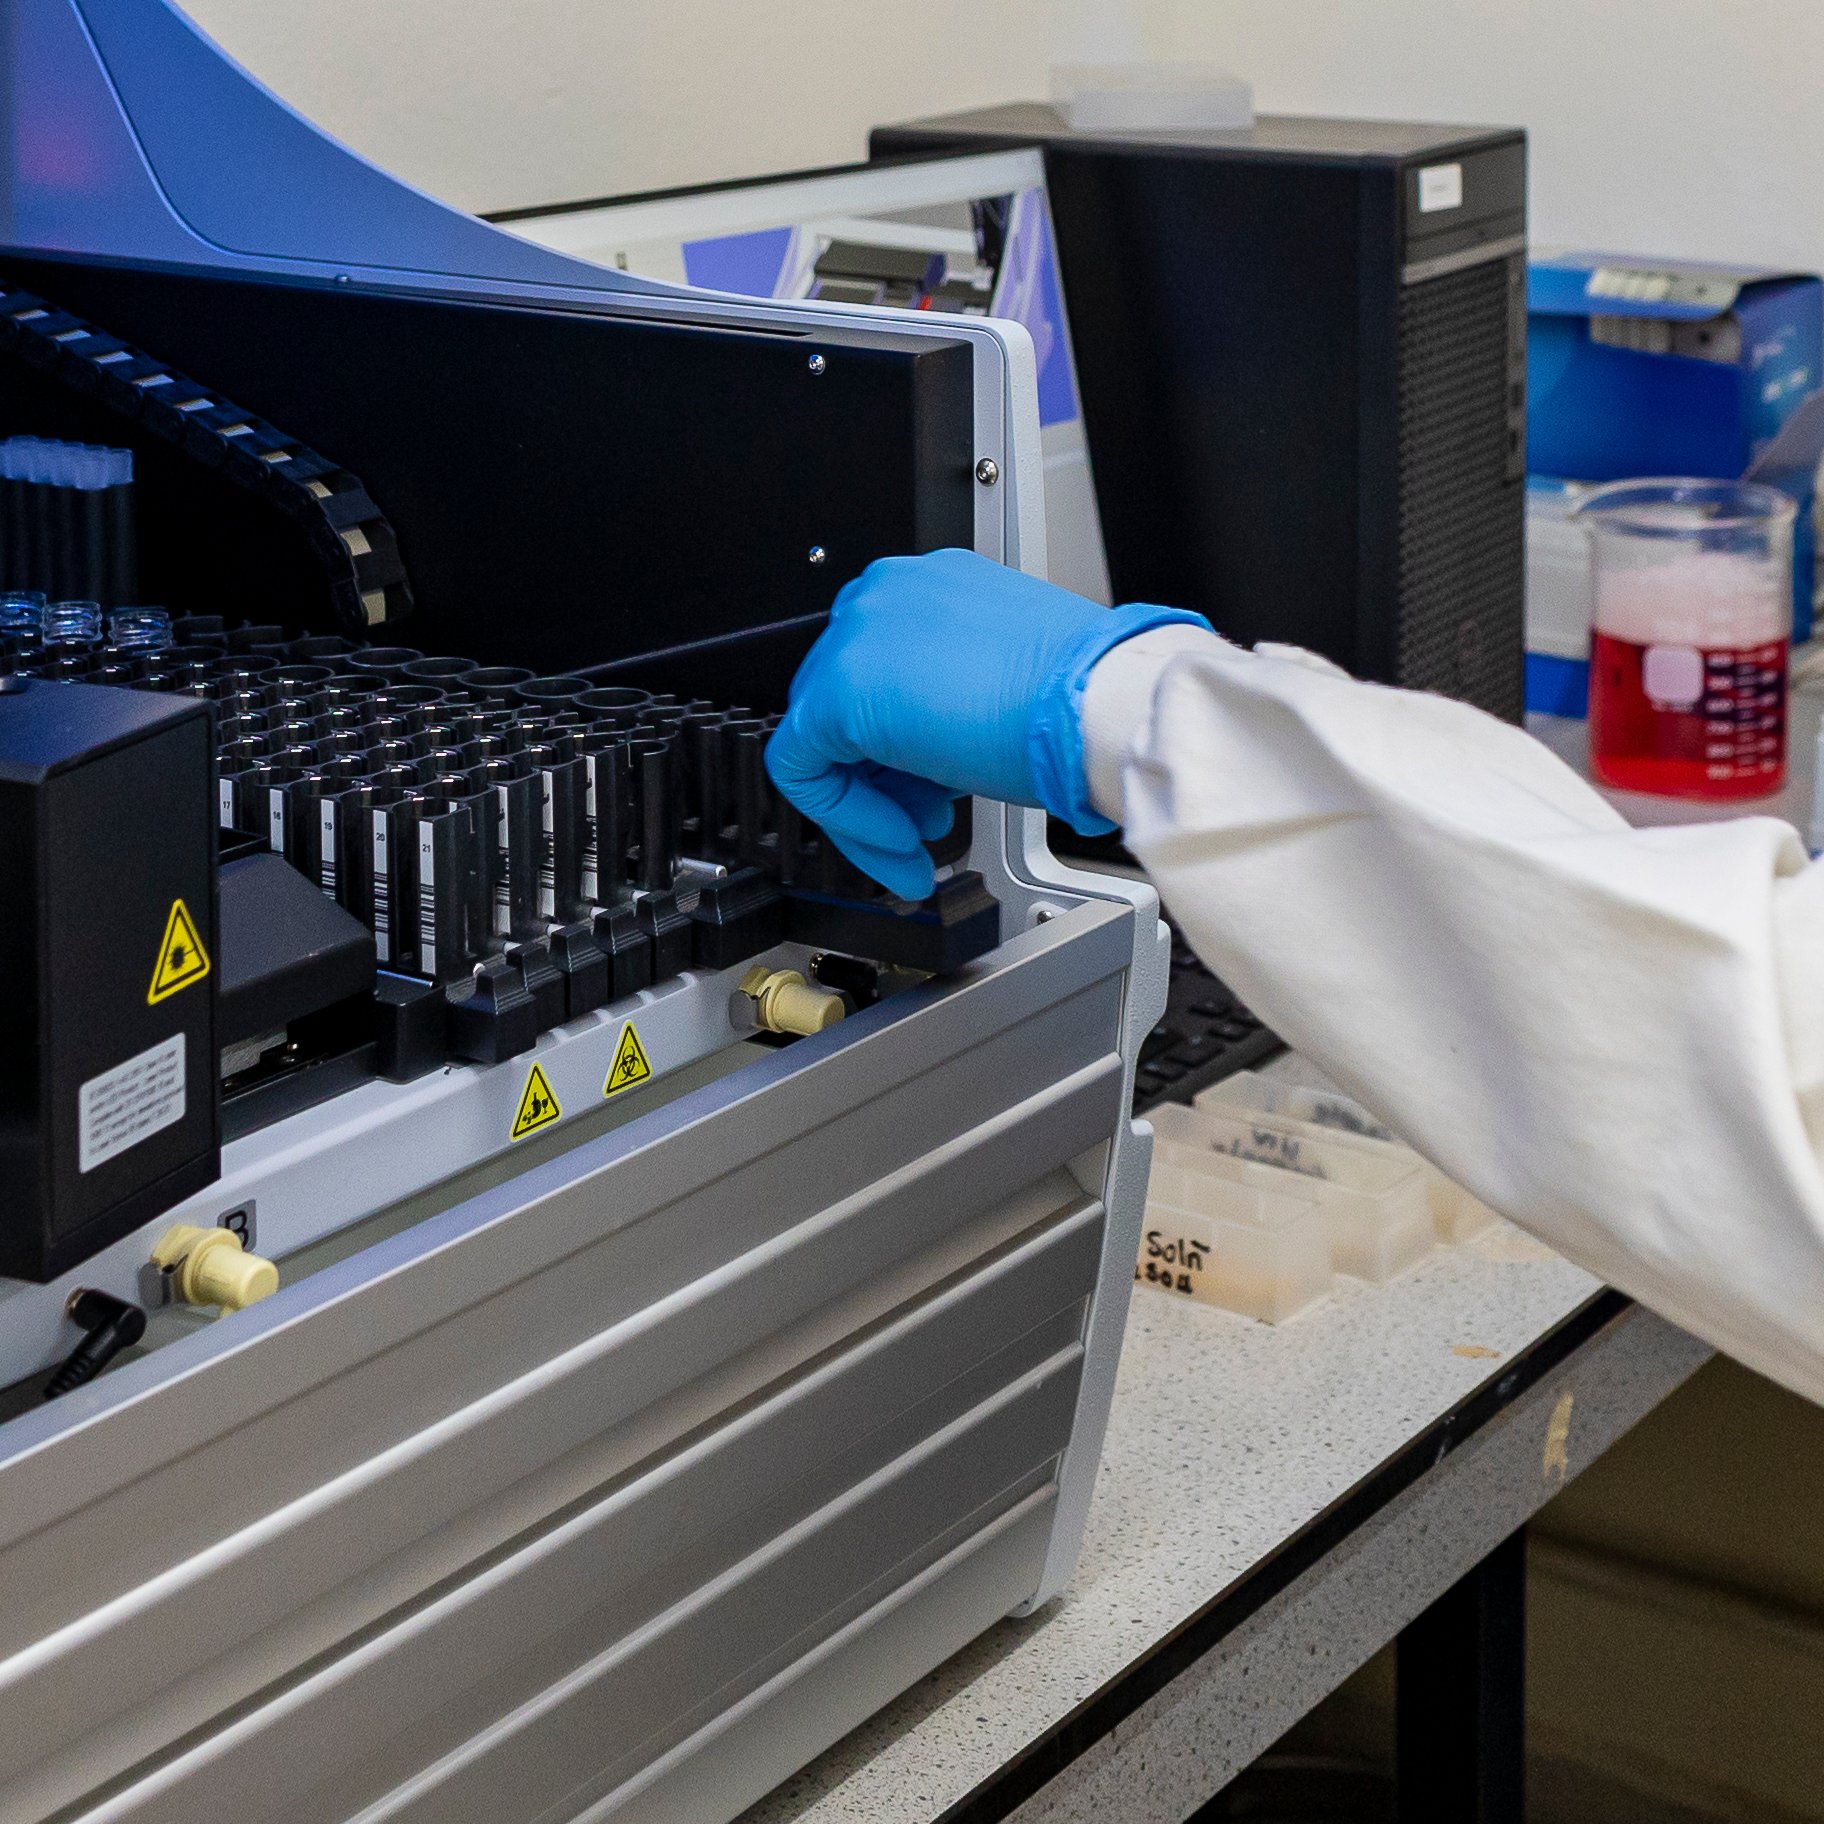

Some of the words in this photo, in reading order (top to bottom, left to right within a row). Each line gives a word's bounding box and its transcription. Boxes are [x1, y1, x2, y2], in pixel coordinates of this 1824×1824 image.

[223, 800, 231, 809] 17
[324, 821, 332, 831] 19
[376, 832, 385, 842] 20
[422, 843, 431, 853] 21
[225, 1209, 249, 1249] B
